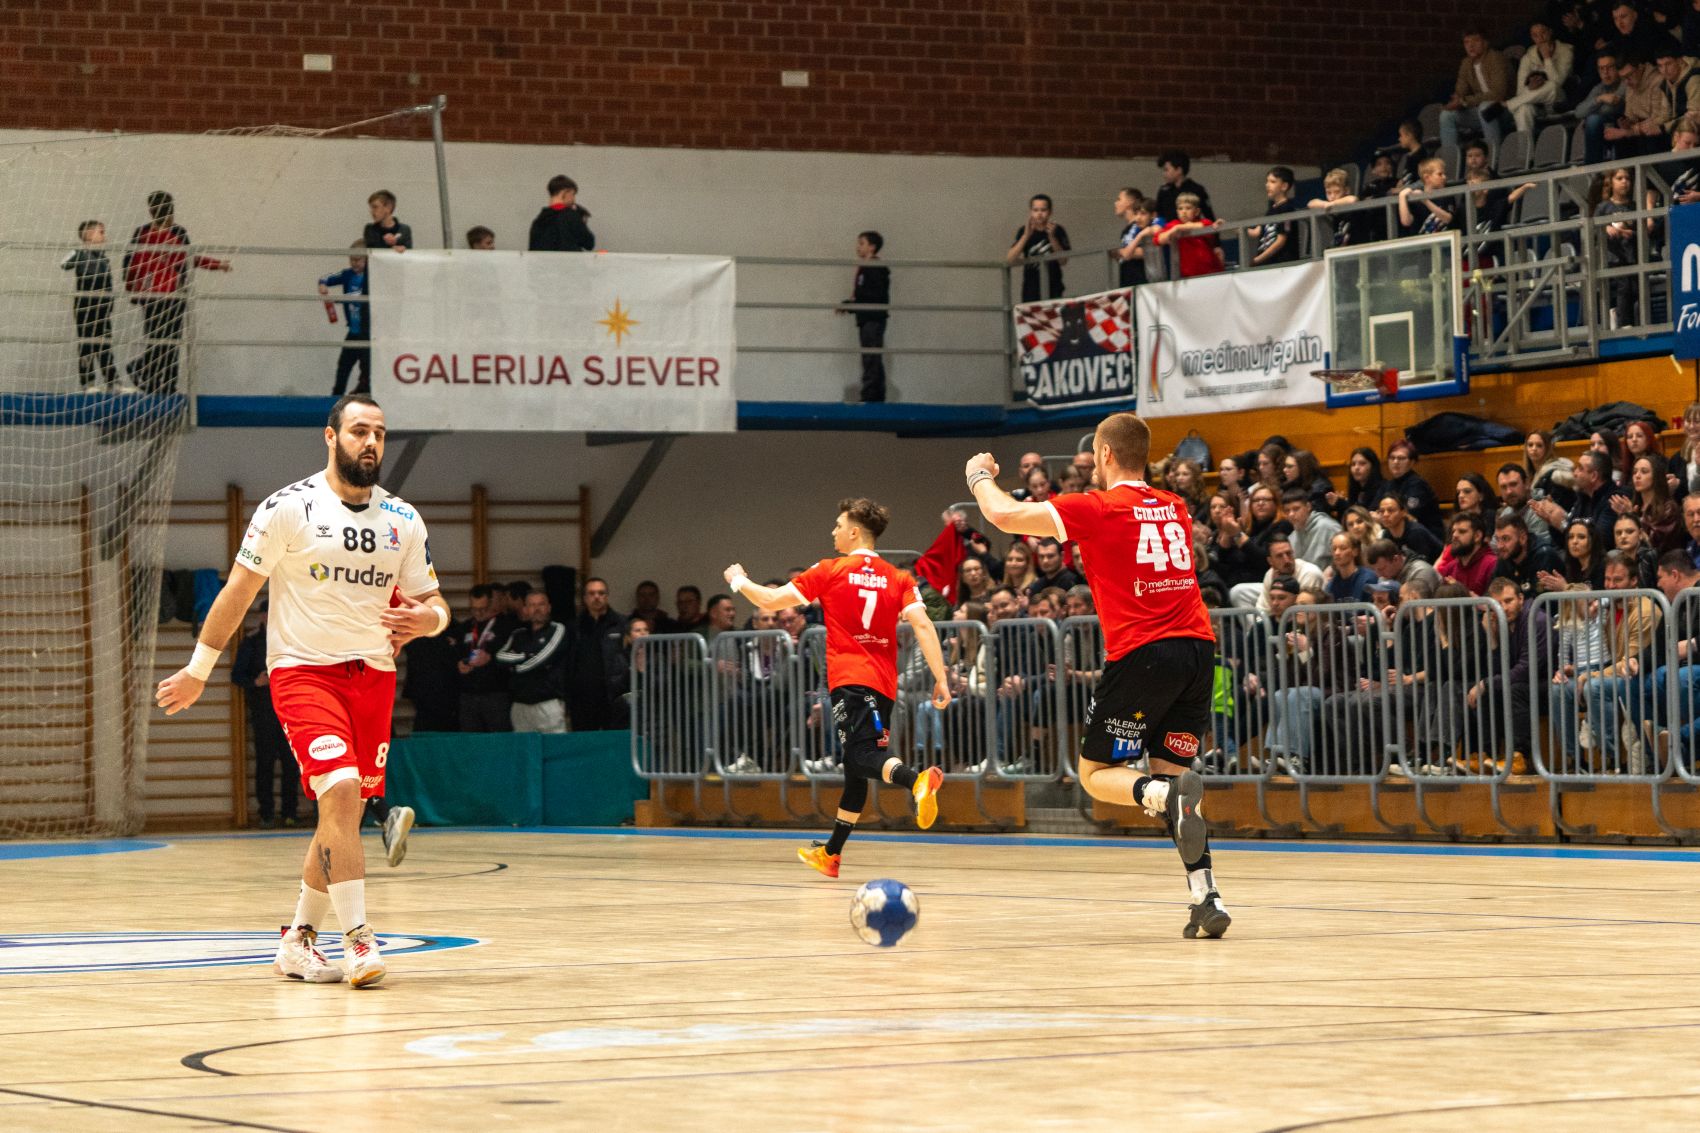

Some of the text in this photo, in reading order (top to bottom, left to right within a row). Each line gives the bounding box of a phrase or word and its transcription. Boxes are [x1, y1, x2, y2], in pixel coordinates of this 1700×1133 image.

[393, 354, 720, 387] GALERIJA SJEVER
[343, 526, 376, 553] 88
[1136, 522, 1191, 572] 48
[858, 589, 877, 630] 7
[1106, 726, 1140, 738] SJEVER
[1116, 738, 1142, 751] TM
